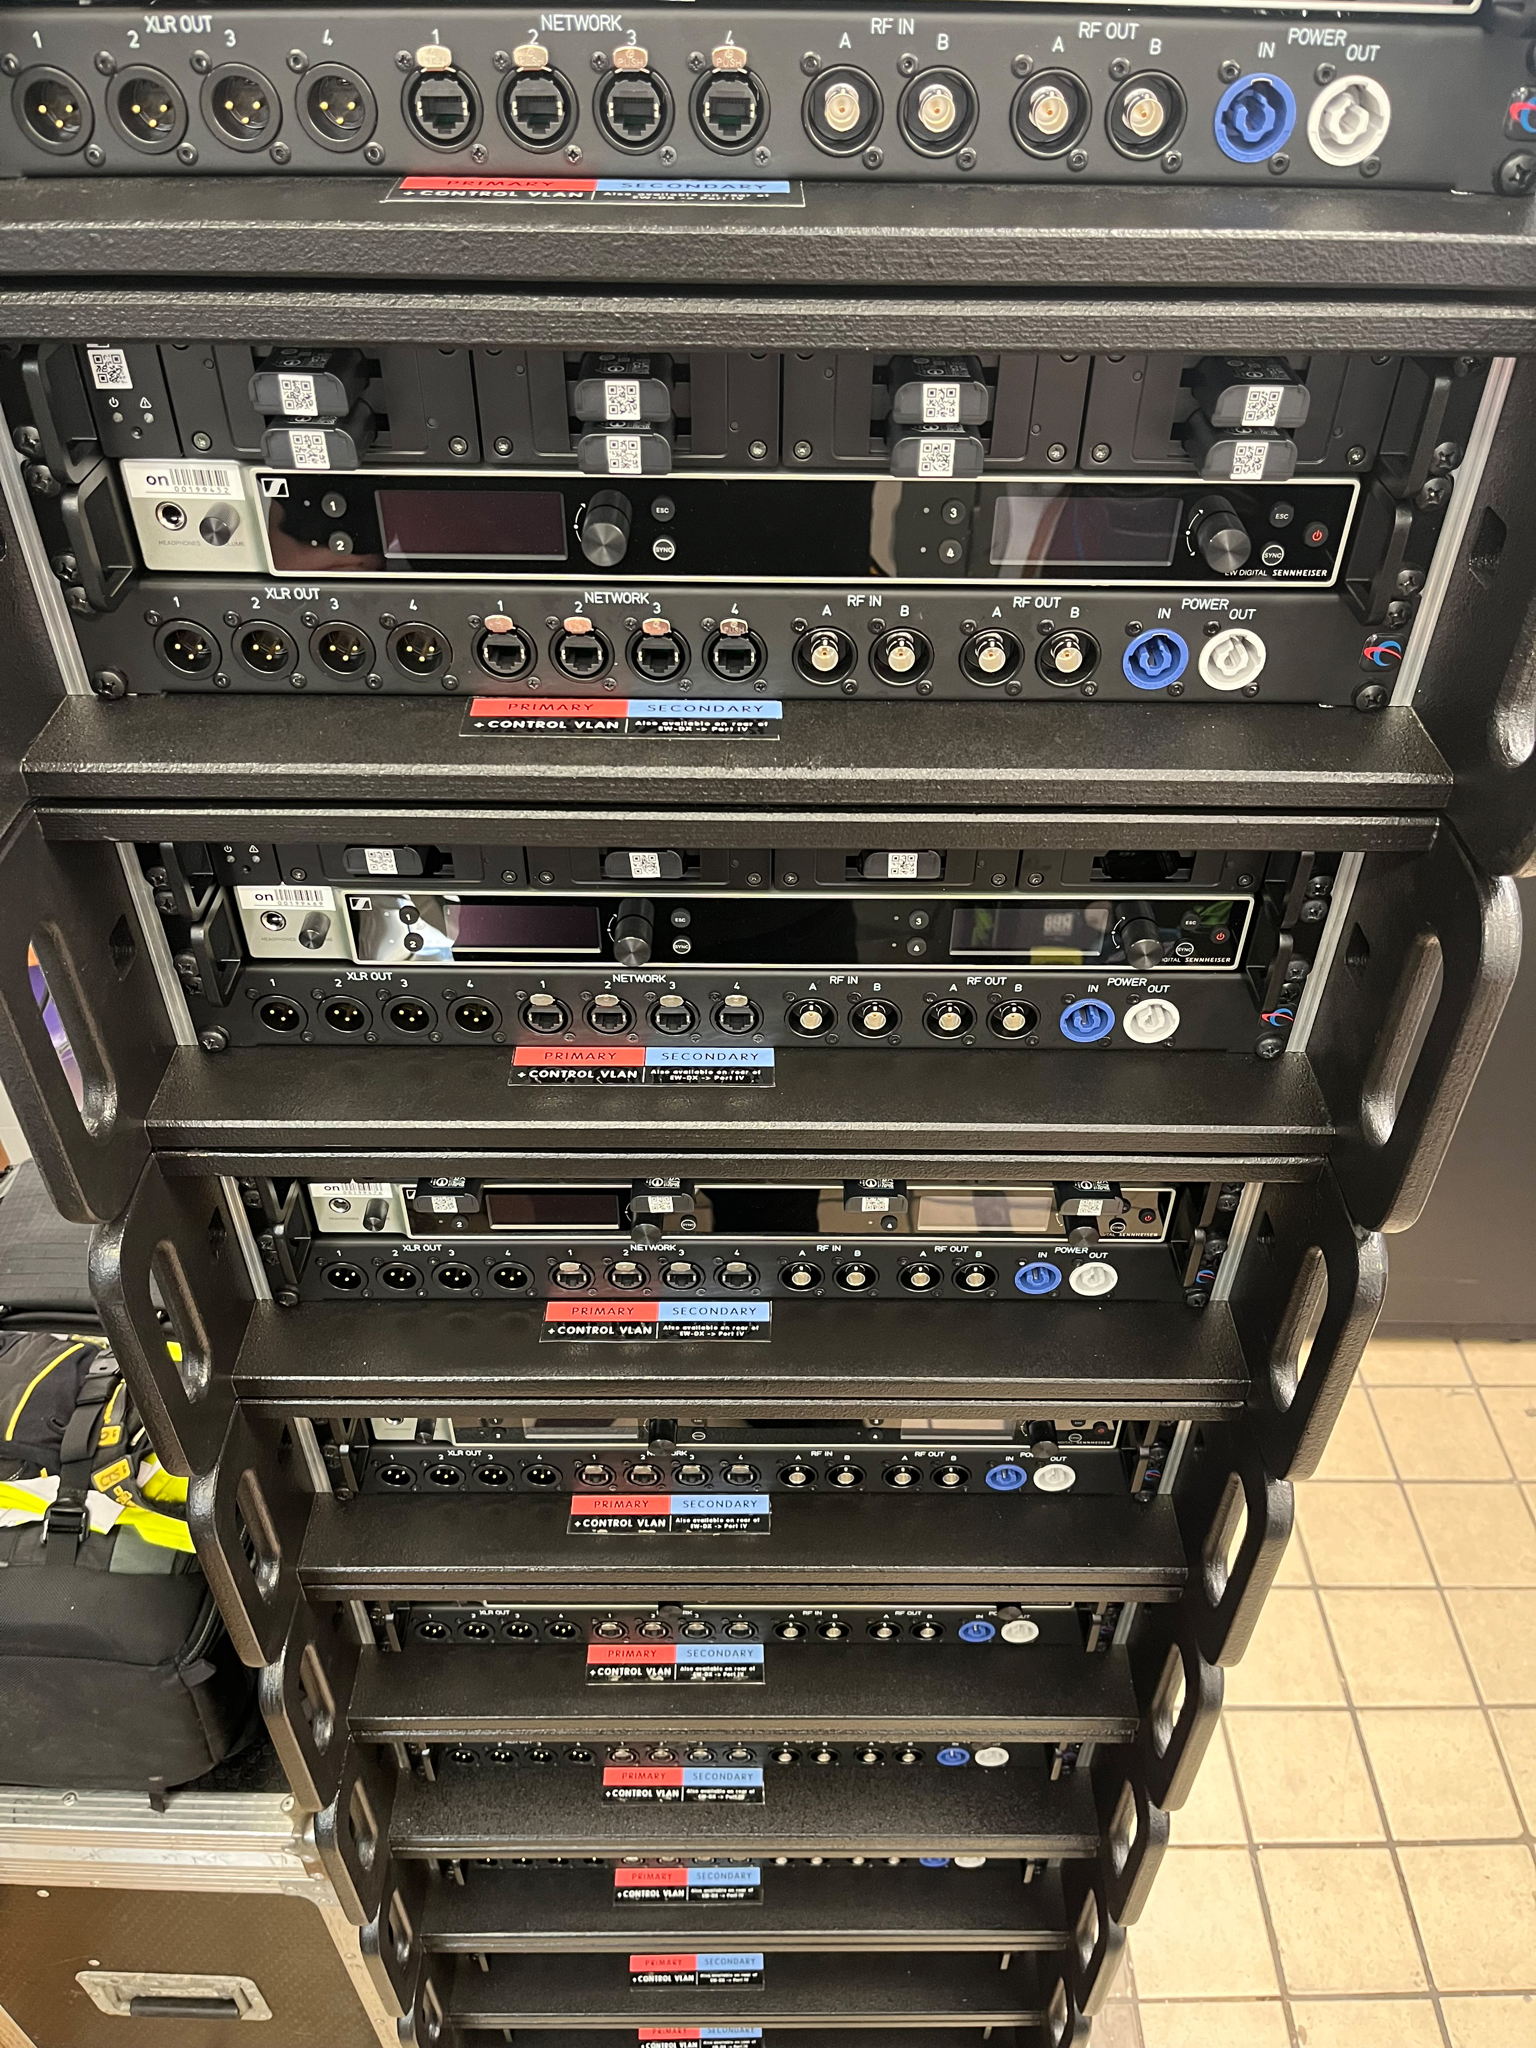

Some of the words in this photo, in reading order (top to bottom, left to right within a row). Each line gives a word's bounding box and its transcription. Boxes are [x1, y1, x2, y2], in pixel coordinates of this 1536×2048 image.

[144, 15, 177, 33] XLR
[180, 15, 212, 33] OUT
[540, 14, 622, 32] NETWORK
[871, 18, 893, 35] RF
[898, 18, 915, 35] IN
[1078, 22, 1101, 39] RF
[1105, 23, 1139, 40] OUT
[32, 30, 42, 48] 1
[127, 30, 140, 48] 2
[224, 30, 236, 47] 3
[322, 29, 334, 46] 4
[431, 29, 440, 45] 1
[528, 29, 539, 45] 2
[626, 29, 637, 46] 3
[724, 30, 735, 46] 4
[839, 32, 851, 49] A
[937, 33, 949, 50] B
[1287, 27, 1347, 47] POWER
[1051, 36, 1065, 52] A
[1150, 38, 1162, 55] B
[1258, 41, 1276, 58] IN
[1345, 44, 1381, 62] OUT
[447, 180, 555, 188] PRIMARY
[621, 182, 768, 190] SECONDARY
[420, 190, 519, 198] CONTROL
[528, 191, 584, 199] VLAN
[146, 475, 169, 486] on
[329, 500, 337, 512] 1
[950, 508, 958, 519] 3
[1275, 513, 1289, 521] ESC
[336, 540, 345, 551] 2
[655, 546, 673, 554] SYNC
[946, 547, 955, 558] 4
[1264, 551, 1282, 560] SYNC
[1239, 569, 1268, 577] DIGITAL
[1272, 569, 1328, 577] SENNHEISER
[264, 587, 290, 600] XLR
[294, 588, 321, 600] OUT
[584, 591, 650, 605] NETWORK
[173, 596, 180, 608] 1
[251, 597, 261, 609] 2
[329, 598, 339, 610] 3
[409, 599, 418, 610] 4
[847, 595, 865, 607] RF
[868, 596, 882, 607] IN
[1012, 596, 1031, 608] RF
[1035, 597, 1061, 609] OUT
[1181, 598, 1229, 611] POWER
[496, 600, 504, 612] 1
[574, 601, 583, 613] 2
[652, 602, 661, 614] 3
[730, 603, 739, 615] 4
[822, 605, 832, 617] A
[900, 605, 910, 617] B
[991, 606, 1002, 618] A
[1070, 607, 1080, 619] B
[1157, 608, 1171, 619] IN
[1229, 609, 1256, 620] OUT
[508, 703, 594, 711] PRIMARY
[647, 704, 764, 713] SECONDARY
[487, 720, 567, 729] CONTROL
[574, 721, 619, 729] VLAN
[254, 893, 274, 901] on
[405, 913, 411, 921] 1
[915, 917, 922, 925] 3
[409, 940, 417, 948] 2
[346, 971, 368, 981] XLR
[370, 971, 393, 981] OUT
[612, 974, 667, 984] NETWORK
[829, 976, 844, 984] RF
[847, 976, 858, 984] IN
[270, 979, 276, 987] 1
[335, 979, 343, 987] 2
[400, 979, 408, 988] 3
[466, 980, 474, 988] 4
[539, 980, 546, 989] 1
[604, 981, 611, 989] 2
[669, 981, 676, 990] 3
[733, 982, 740, 990] 4
[966, 977, 982, 986] RF
[984, 977, 1007, 986] OUT
[1107, 978, 1147, 987] POWER
[809, 983, 817, 991] A
[873, 983, 881, 991] B
[949, 984, 958, 992] A
[1014, 984, 1022, 992] B
[1087, 984, 1099, 993] IN
[1147, 984, 1170, 993] OUT
[544, 1052, 617, 1060] PRIMARY
[661, 1052, 759, 1060] SECONDARY
[529, 1070, 595, 1078] CONTROL
[600, 1070, 637, 1078] VLAN
[402, 1244, 421, 1252] XLR
[422, 1244, 442, 1252] OUT
[630, 1244, 676, 1252] NETWORK
[934, 1245, 947, 1253] RF
[949, 1245, 969, 1253] OUT
[392, 1249, 399, 1257] 2
[448, 1249, 455, 1257] 3
[678, 1249, 685, 1257] 3
[571, 1307, 634, 1315] PRIMARY
[672, 1307, 757, 1315] SECONDARY
[557, 1326, 615, 1334] CONTROL
[619, 1326, 652, 1334] VLAN
[594, 1500, 649, 1508] PRIMARY
[683, 1500, 758, 1508] SECONDARY
[583, 1519, 632, 1527] CONTROL
[637, 1519, 666, 1527] VLAN
[686, 1649, 754, 1657] SECONDARY
[597, 1667, 642, 1676] CONTROL
[646, 1667, 672, 1676] VLAN
